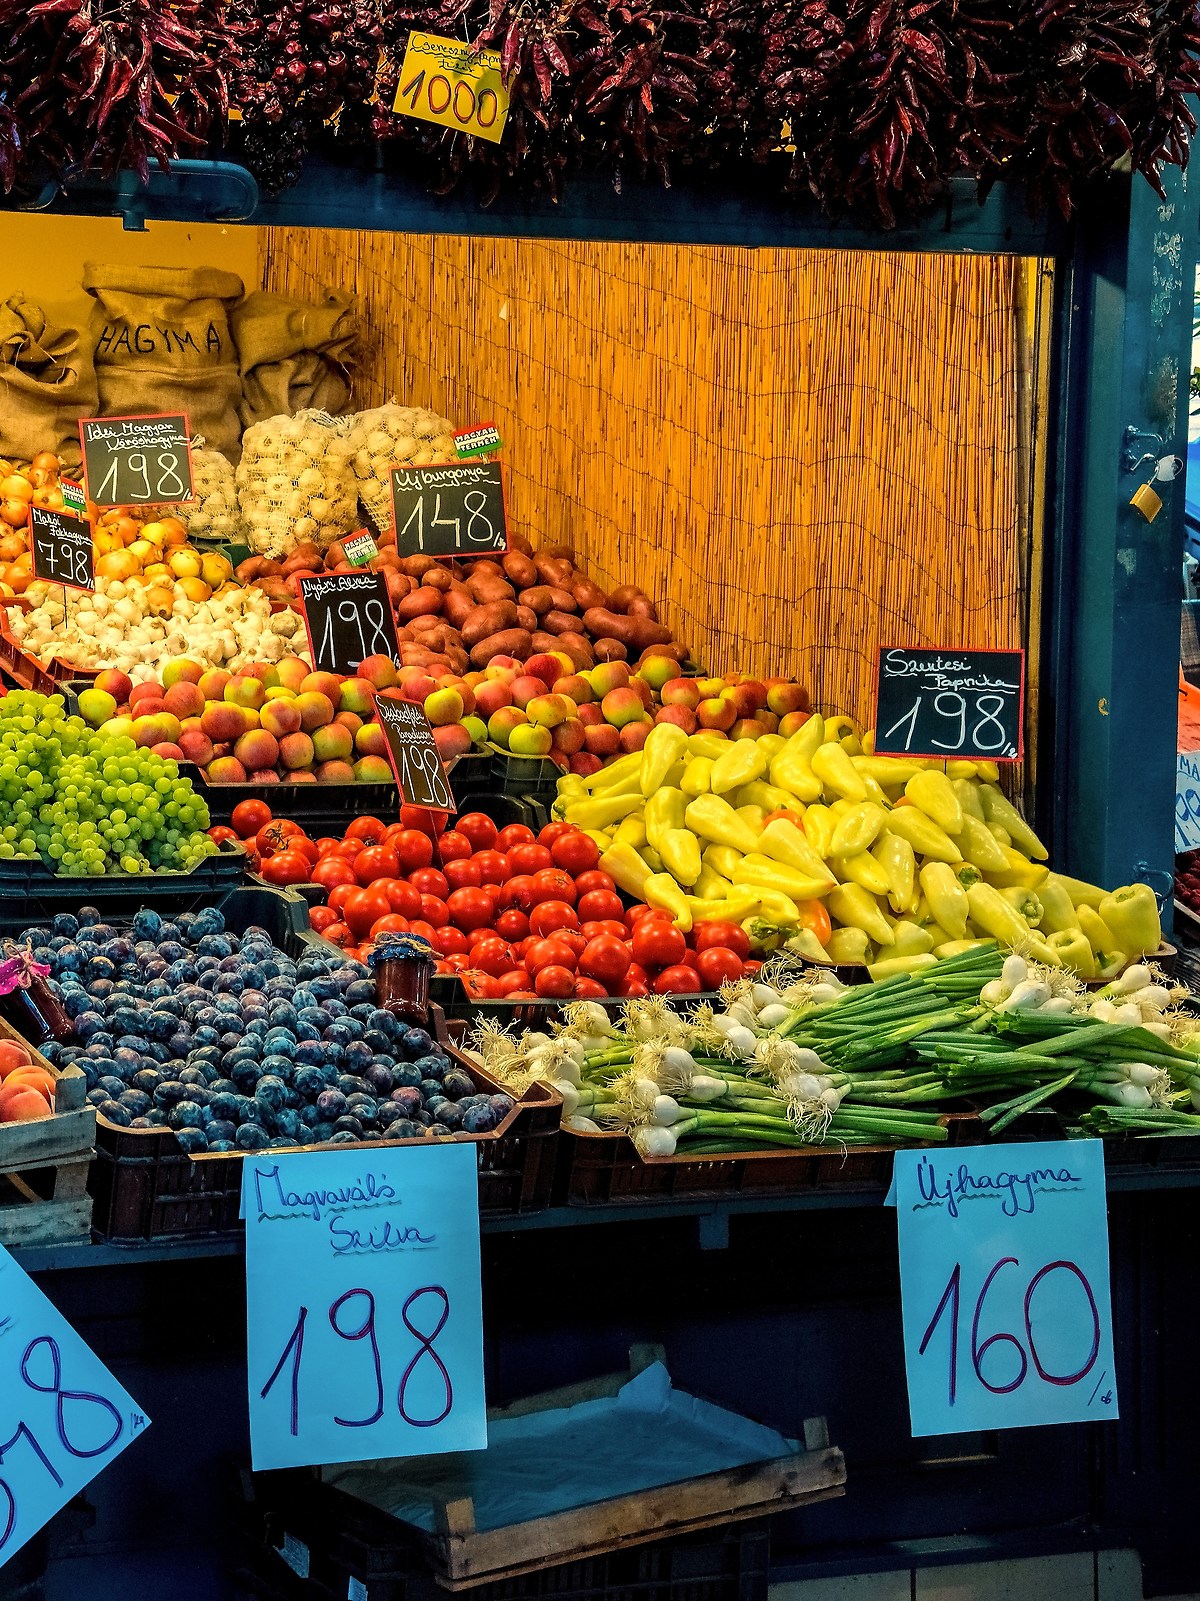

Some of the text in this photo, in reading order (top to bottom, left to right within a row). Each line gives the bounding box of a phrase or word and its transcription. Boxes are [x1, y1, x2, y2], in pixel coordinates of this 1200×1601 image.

[402, 70, 497, 127] 1000
[94, 322, 221, 354] HAGYMA
[121, 422, 174, 437] Magyar
[455, 426, 498, 443] MAGYAR
[106, 434, 190, 452] Vöröshagyma
[460, 436, 498, 452] TERMÉK
[396, 468, 490, 490] Újburgonya
[344, 533, 373, 551] MAGYAR
[349, 544, 376, 561] TERMÉK
[885, 649, 972, 674] Szentesi
[925, 674, 1020, 692] Paprika
[254, 1165, 396, 1221] Magvaváló
[917, 1155, 1082, 1218] Újhagyma
[329, 1215, 437, 1251] Szilva
[260, 1284, 453, 1437] 198
